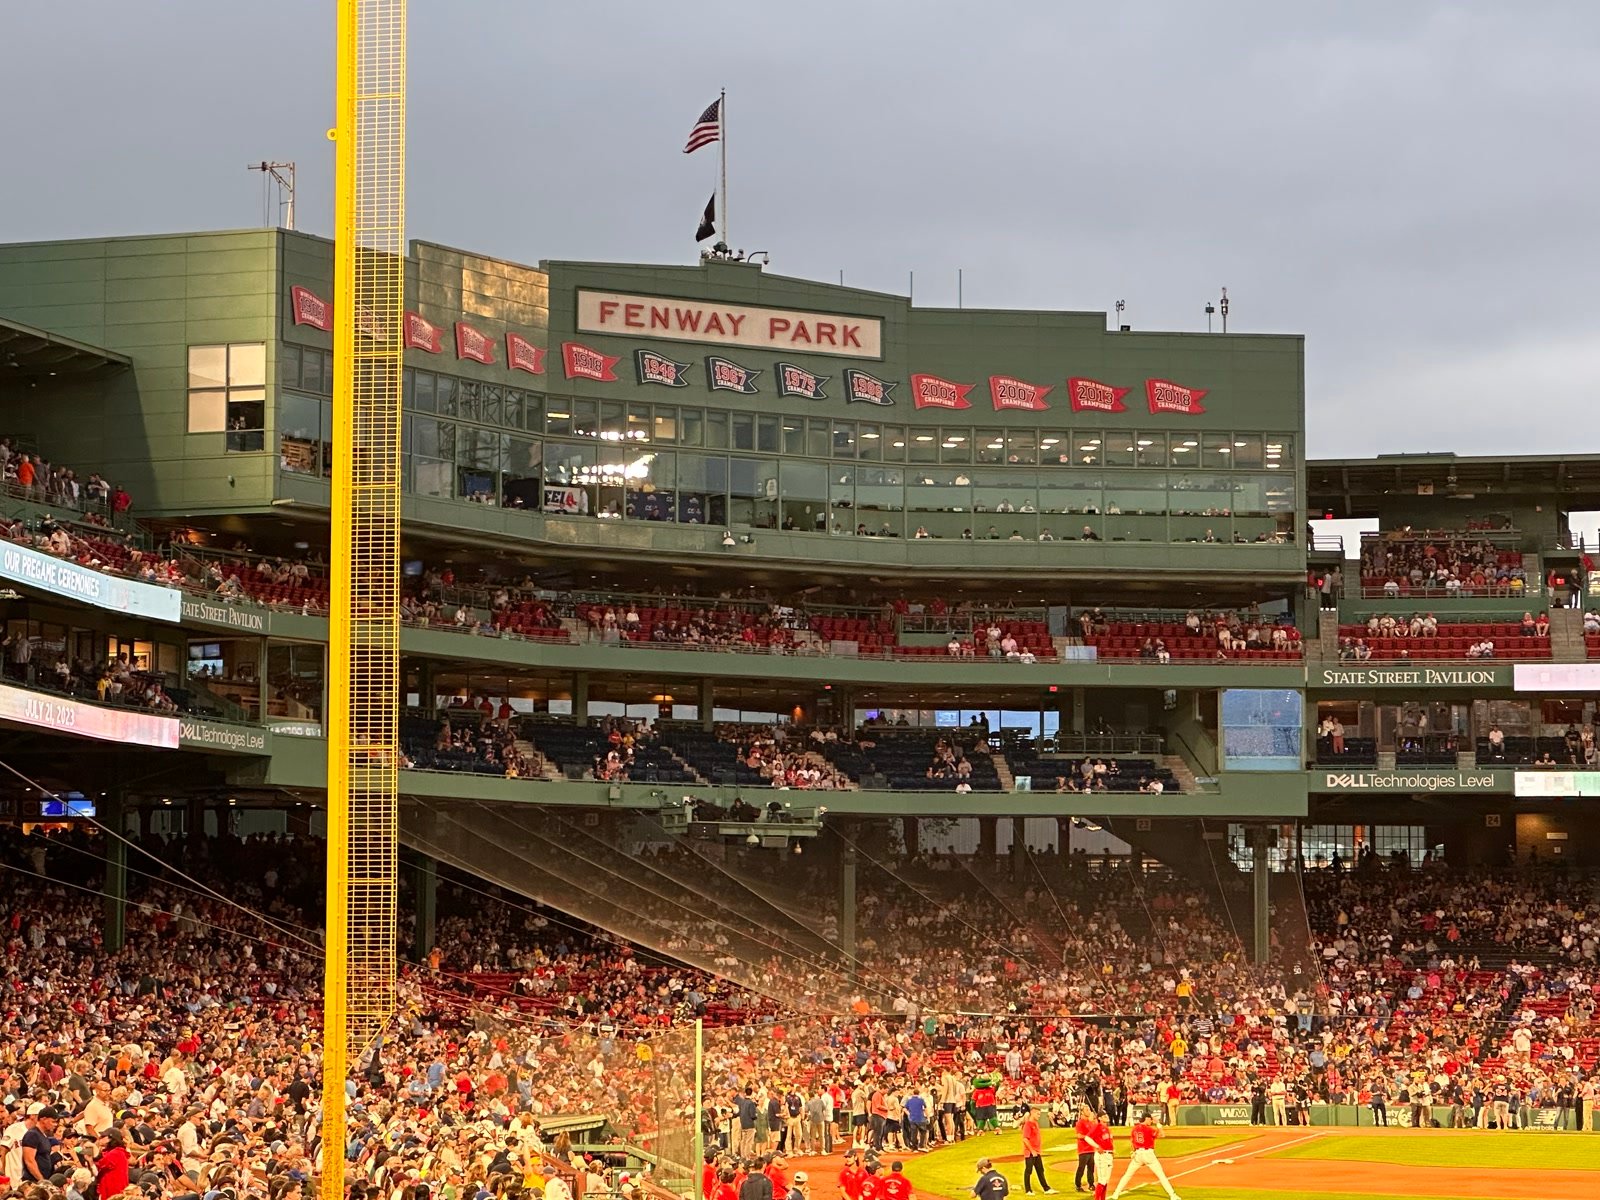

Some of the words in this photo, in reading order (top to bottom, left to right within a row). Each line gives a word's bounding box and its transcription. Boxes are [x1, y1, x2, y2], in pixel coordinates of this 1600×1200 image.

[599, 300, 746, 336] FENWAY
[769, 317, 862, 348] PARK
[573, 351, 603, 373] 1918
[644, 358, 676, 380] 1946
[574, 366, 602, 378] CHAMPIONS
[646, 373, 674, 385] CHAMPIONS
[714, 365, 747, 386] 1967
[717, 380, 744, 392] CHAMPIONS
[784, 371, 816, 392] 1975
[853, 377, 883, 399] 1986
[787, 386, 814, 398] CHAMPIONS
[855, 392, 881, 404] CHAMPIONS
[920, 383, 957, 401] 2004
[998, 384, 1036, 403] 2007
[1077, 386, 1115, 406] 2013
[1155, 388, 1192, 407] 2018
[924, 397, 955, 407] CHAMPIONS
[1002, 398, 1034, 409] CHAMPIONS
[1080, 400, 1112, 411] CHAMPIONS
[1157, 402, 1190, 412] CHAMPIONS
[4, 550, 20, 573] OUR
[21, 554, 57, 585] PREGAME
[57, 566, 100, 598] CEREMONIES
[180, 601, 199, 618] TATE
[200, 602, 227, 622] STREET
[228, 607, 263, 630] PAVILION
[1323, 670, 1365, 684] STATE
[1368, 670, 1419, 684] STREET
[1425, 669, 1495, 684] PAVILION
[25, 699, 44, 720] JULY
[56, 705, 75, 726] 2023
[180, 723, 201, 740] DELL
[201, 725, 246, 749] Technologies
[246, 732, 264, 748] Level
[1326, 773, 1369, 787] DELL
[1368, 774, 1455, 790] Technologies
[1459, 774, 1494, 787] Level
[1220, 1108, 1248, 1118] WM
